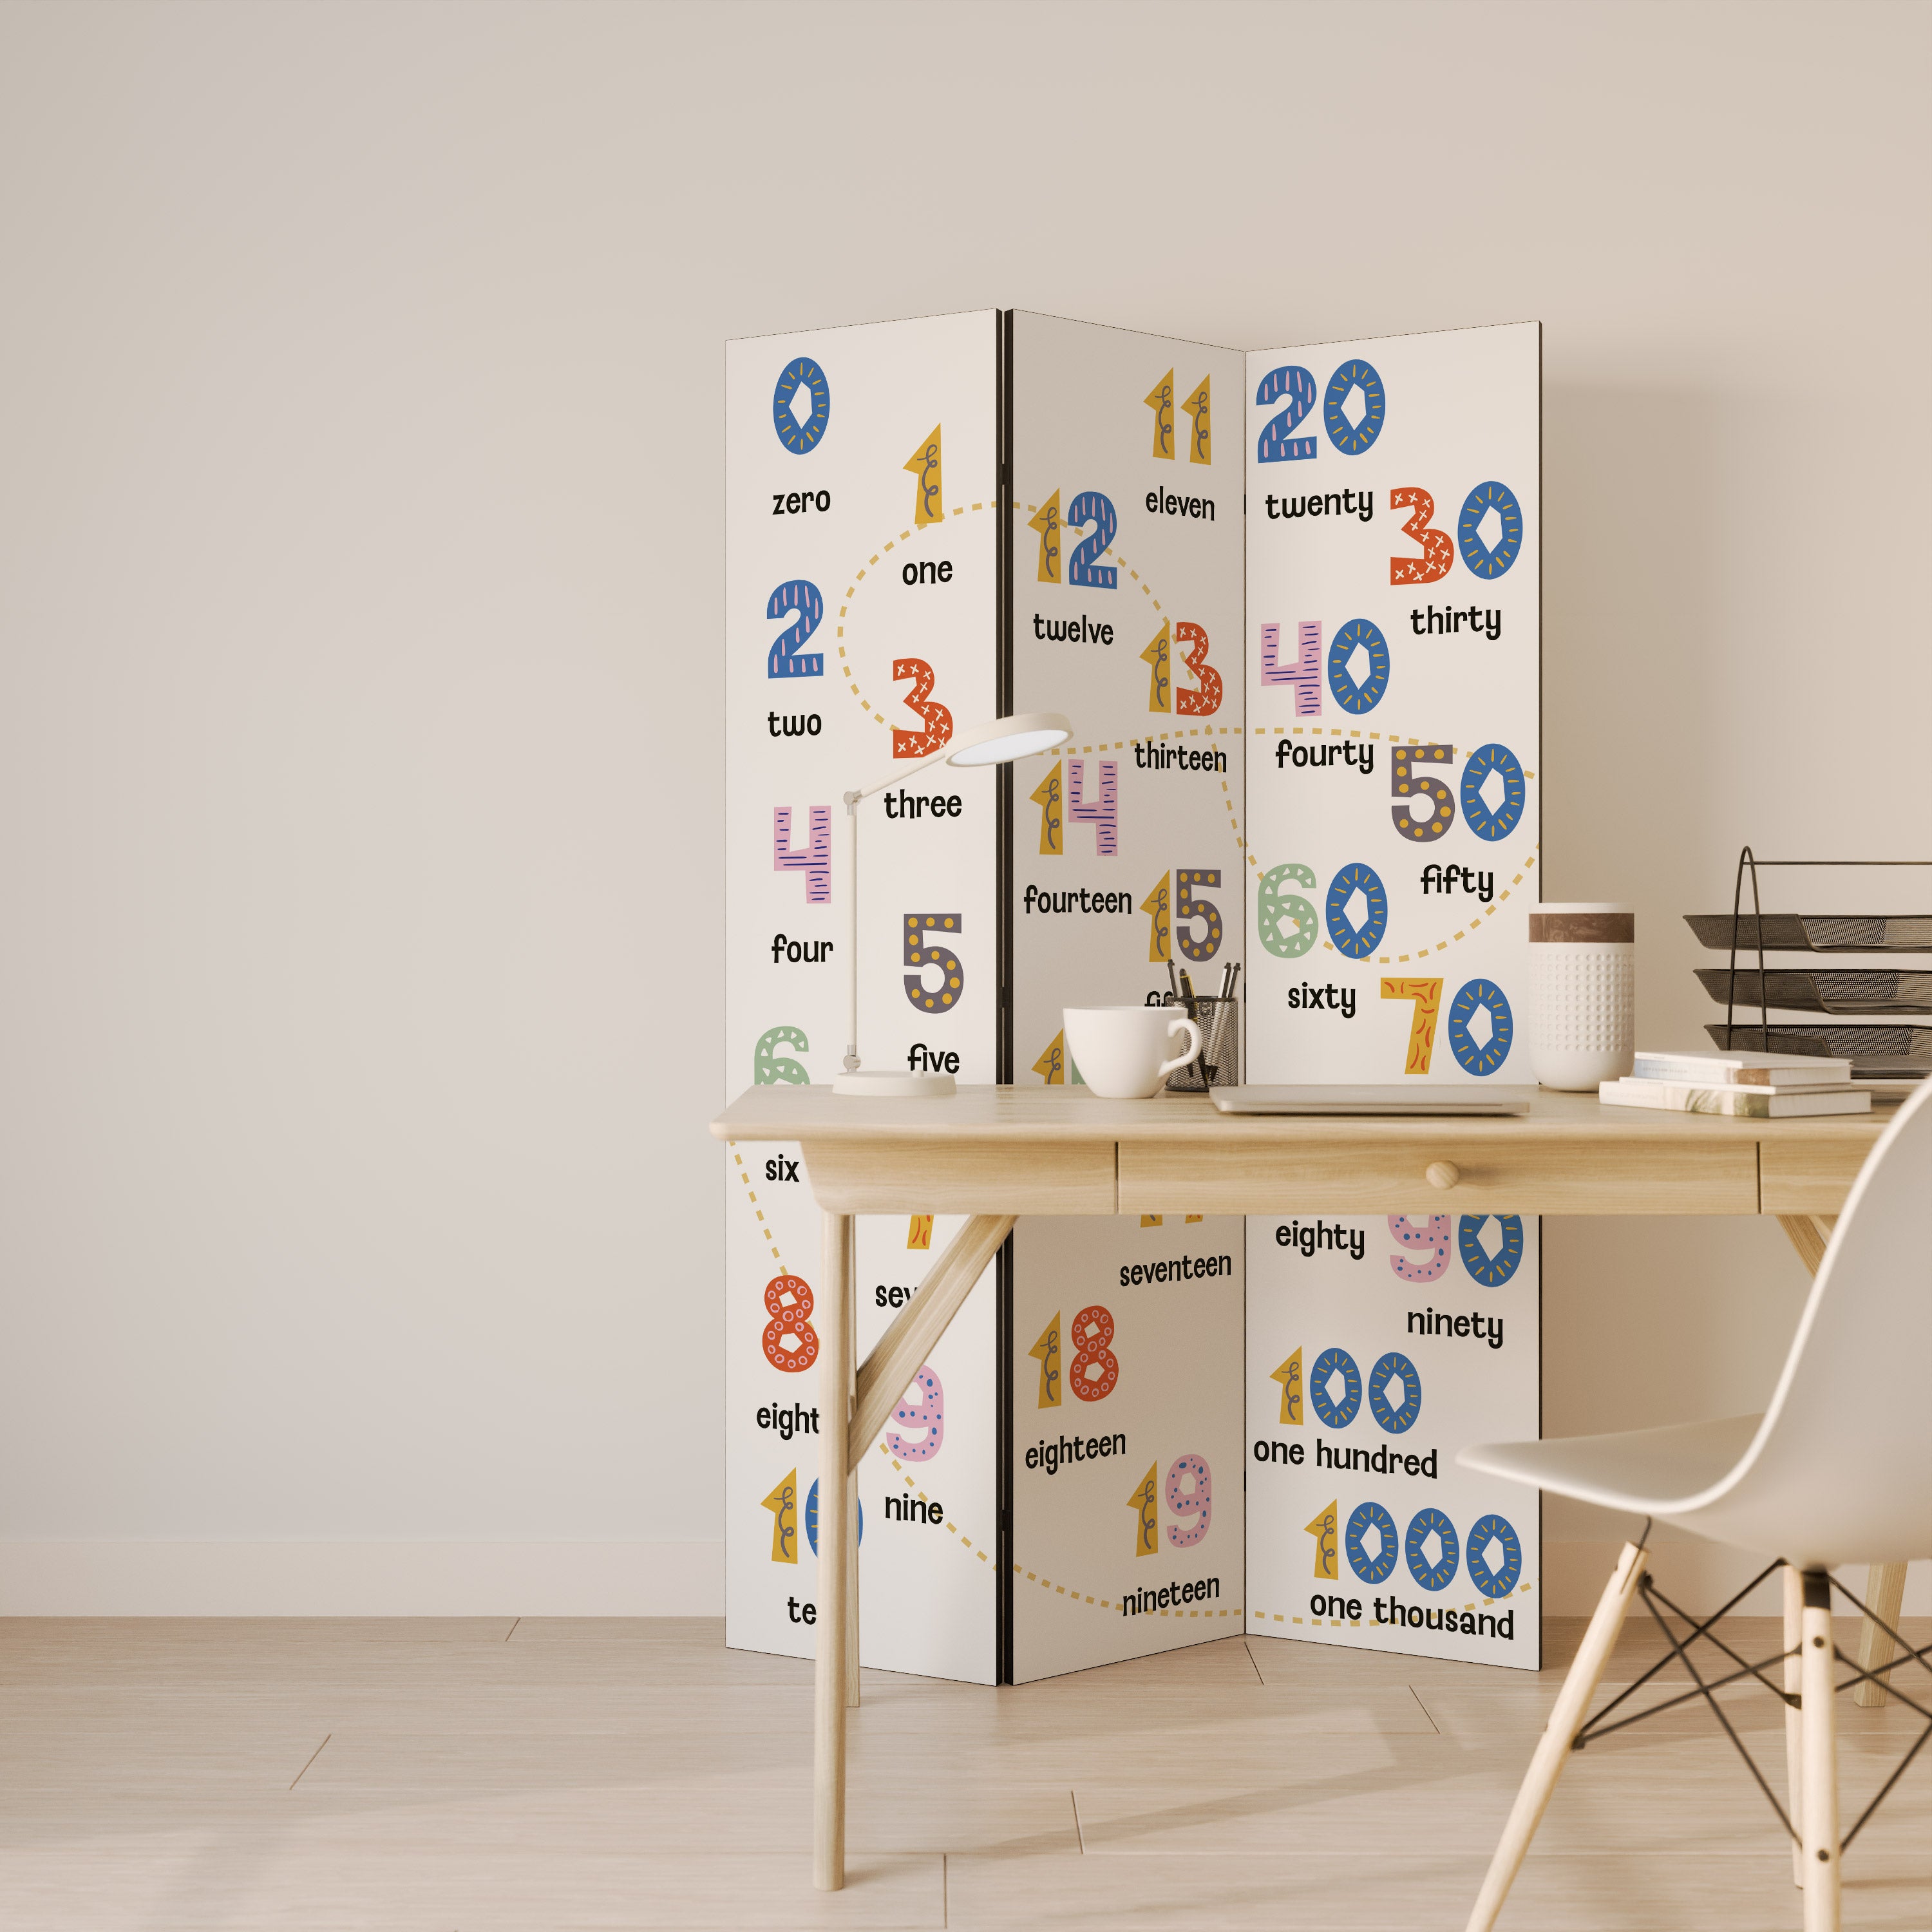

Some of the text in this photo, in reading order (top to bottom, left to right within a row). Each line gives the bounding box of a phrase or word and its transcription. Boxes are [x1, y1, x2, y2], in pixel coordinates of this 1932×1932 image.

[773, 357, 830, 455] 0
[1144, 368, 1211, 465] 11
[1256, 359, 1386, 463] 20
[903, 422, 943, 524] 1
[773, 491, 830, 515] zero
[1146, 486, 1214, 520] eleven
[1265, 489, 1372, 522] twenty
[1027, 488, 1117, 589] 12
[1390, 481, 1523, 585] 30
[903, 561, 952, 585] one
[766, 580, 824, 679] 2
[1034, 614, 1113, 645] twelve
[1411, 605, 1501, 640] thirty
[1140, 618, 1222, 716] 13
[1261, 618, 1390, 717] 40
[768, 712, 821, 737] two
[893, 658, 952, 759] 3
[1135, 741, 1226, 772] thirteen
[1276, 739, 1373, 774] fourty
[884, 790, 961, 819] three
[1030, 760, 1118, 855] 14
[1392, 743, 1525, 842] 50
[774, 806, 831, 904] 4
[1024, 885, 1132, 914] fourteen
[1421, 864, 1493, 902] fifty
[1139, 869, 1222, 962] 15
[1258, 863, 1388, 959] 60
[772, 934, 833, 963] four
[904, 914, 963, 1014] 5
[1289, 982, 1355, 1018] sixty
[1381, 978, 1513, 1077] 70
[755, 1027, 810, 1084] 6
[908, 1044, 959, 1074] five
[766, 1154, 799, 1182] six
[1276, 1220, 1364, 1260] eighty
[1388, 1215, 1524, 1287] 90
[1121, 1256, 1231, 1286] seventeen
[762, 1275, 819, 1372] 8
[1408, 1307, 1502, 1349] ninety
[1028, 1305, 1119, 1409] 18
[1270, 1347, 1421, 1434] 100
[757, 1403, 819, 1440] eight
[886, 1365, 943, 1462] 9
[1026, 1434, 1125, 1475] eighteen
[1254, 1439, 1437, 1479] one hundred
[886, 1493, 943, 1524] nine
[1126, 1454, 1212, 1557] 19
[1303, 1499, 1522, 1598] 1000
[788, 1597, 816, 1625] te
[1123, 1578, 1219, 1616] nineteen
[1311, 1595, 1513, 1640] one thousand
